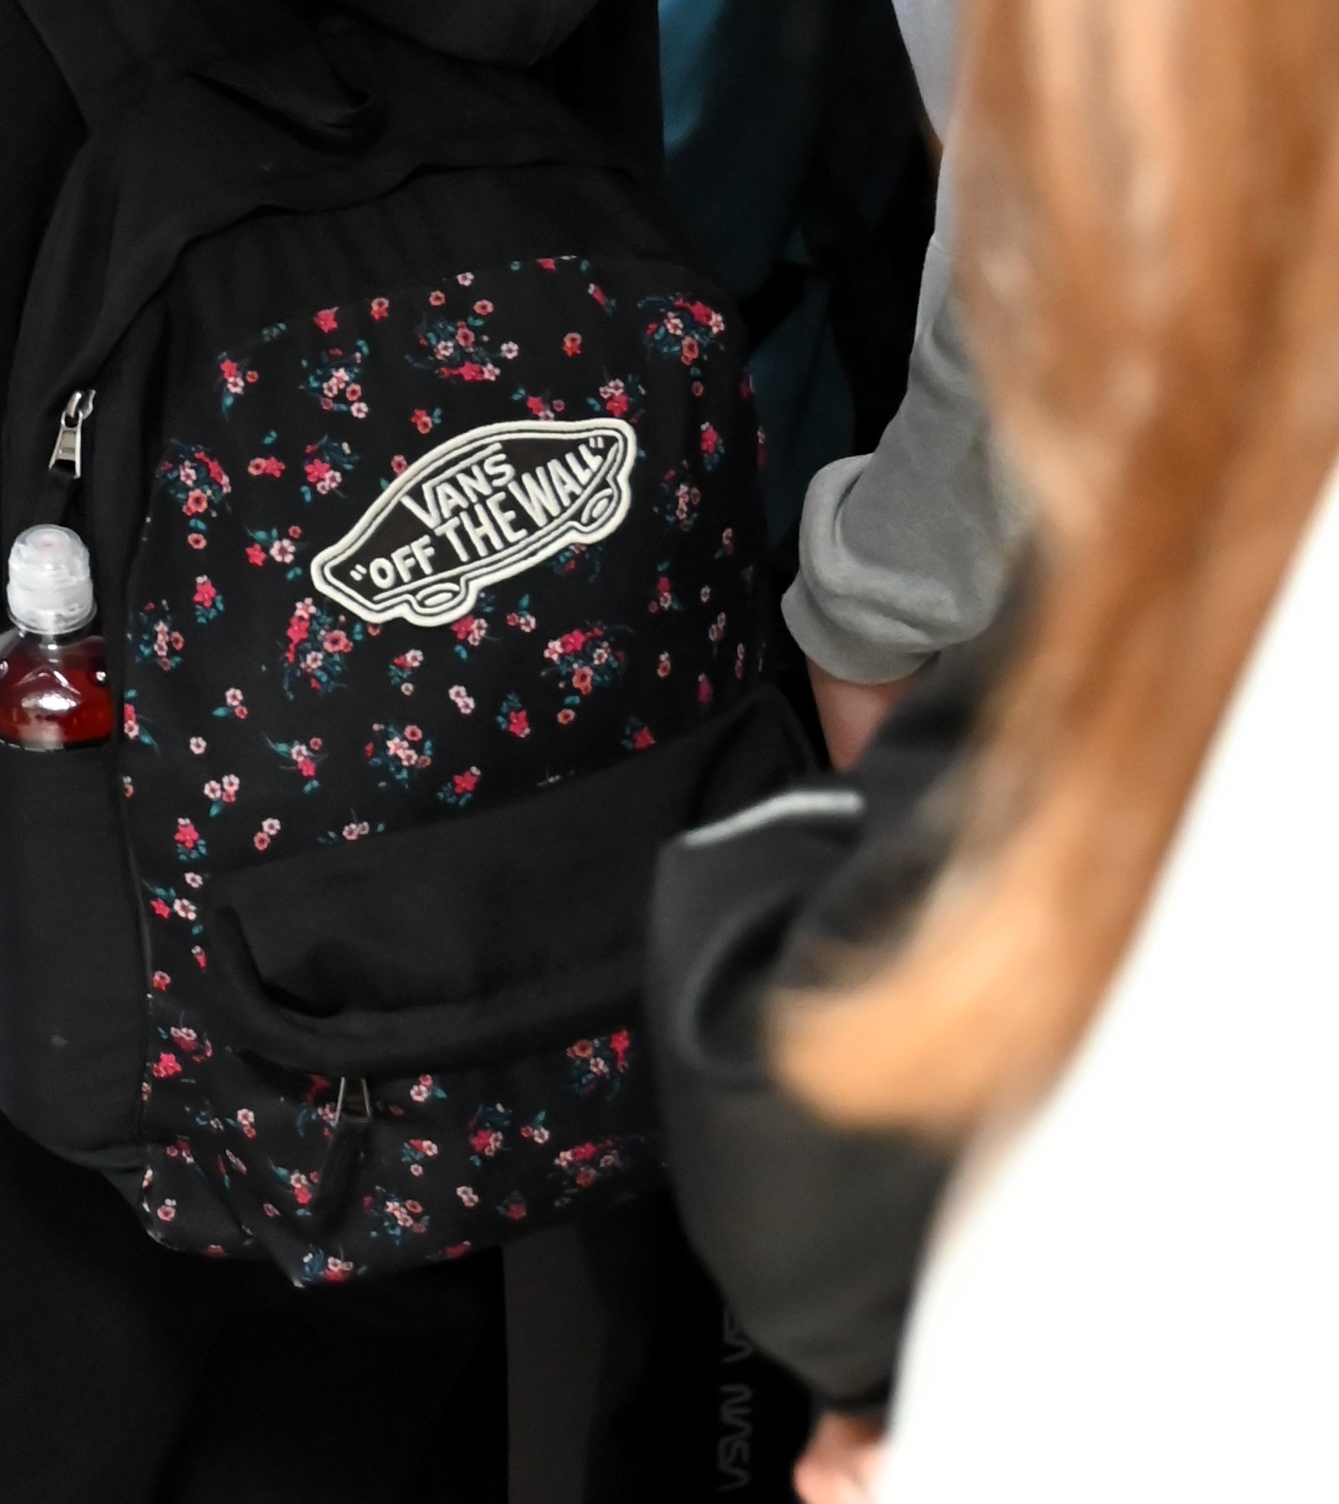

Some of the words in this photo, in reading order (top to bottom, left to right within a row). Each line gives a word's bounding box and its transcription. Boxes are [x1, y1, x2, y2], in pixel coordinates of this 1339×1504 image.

[401, 443, 515, 530] VANS
[433, 491, 527, 563] THE
[719, 1383, 753, 1492] NASA
